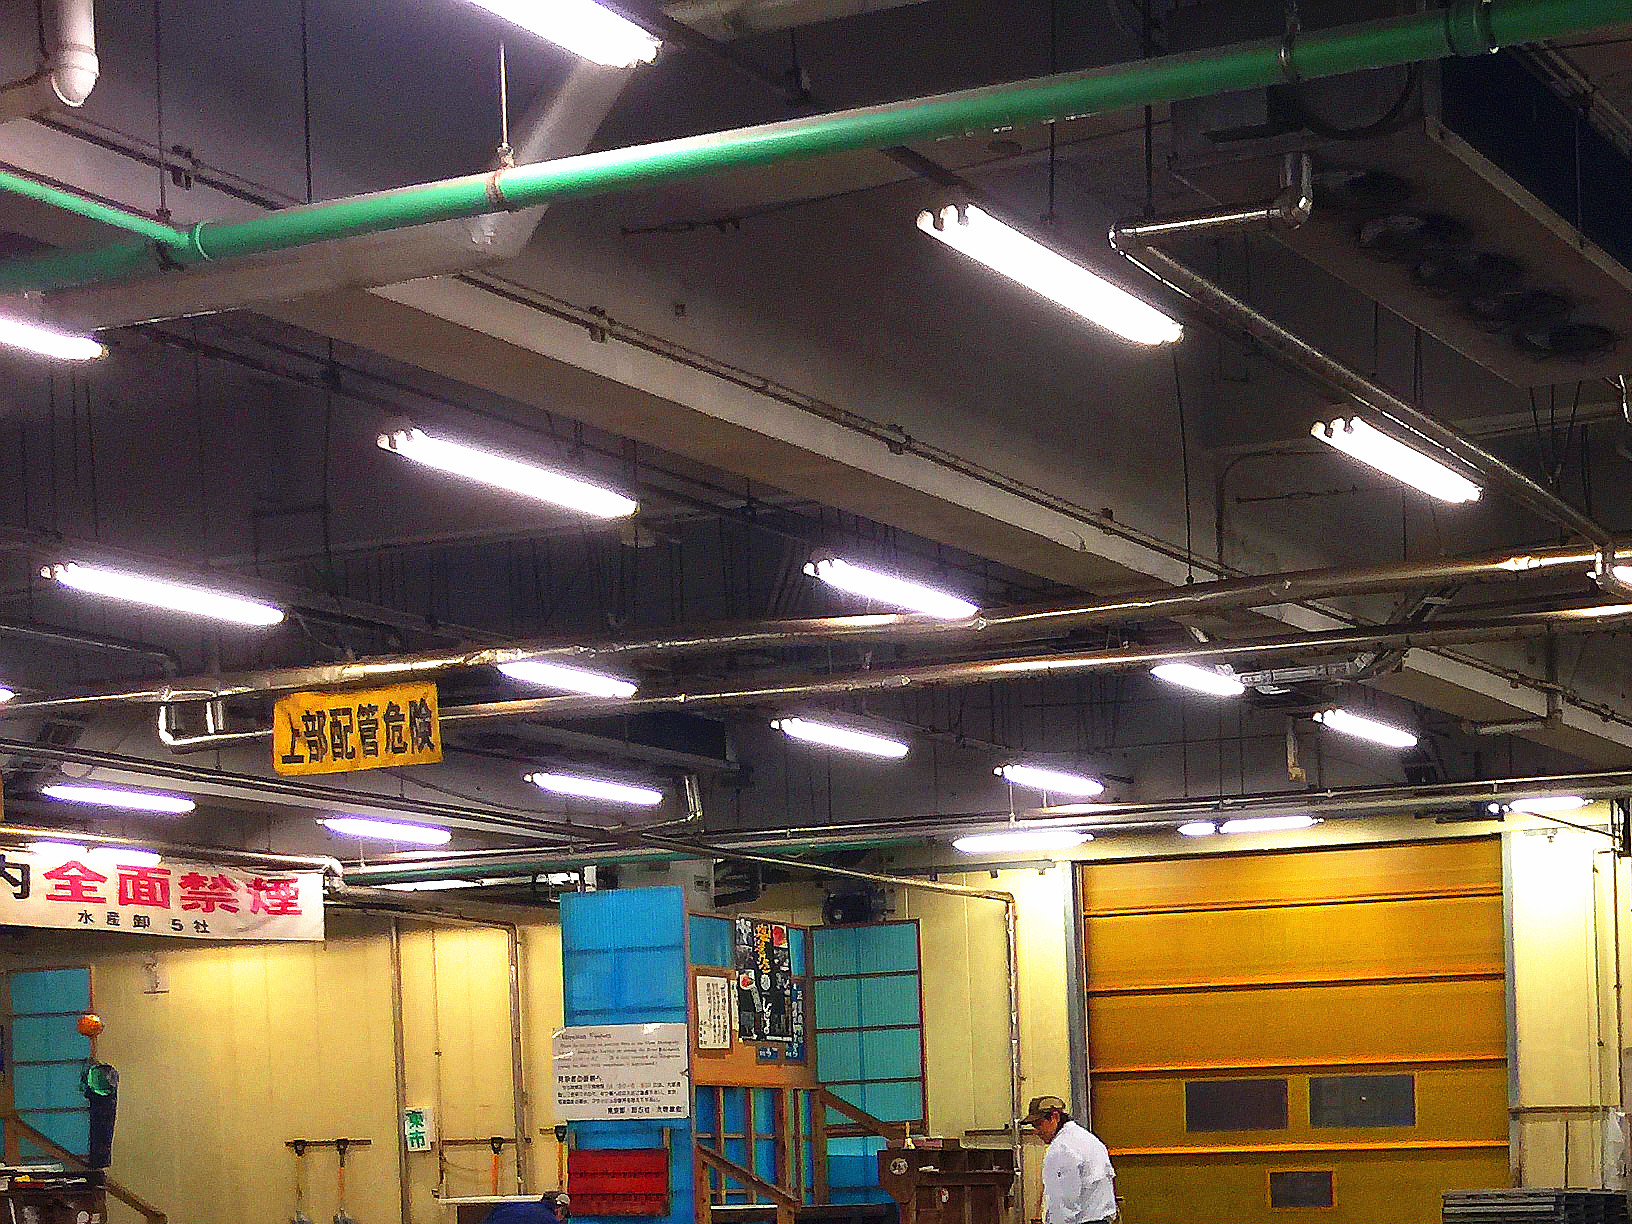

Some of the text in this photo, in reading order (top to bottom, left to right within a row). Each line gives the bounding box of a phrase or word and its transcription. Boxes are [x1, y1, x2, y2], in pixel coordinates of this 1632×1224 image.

[281, 697, 436, 765] 上部配管危険
